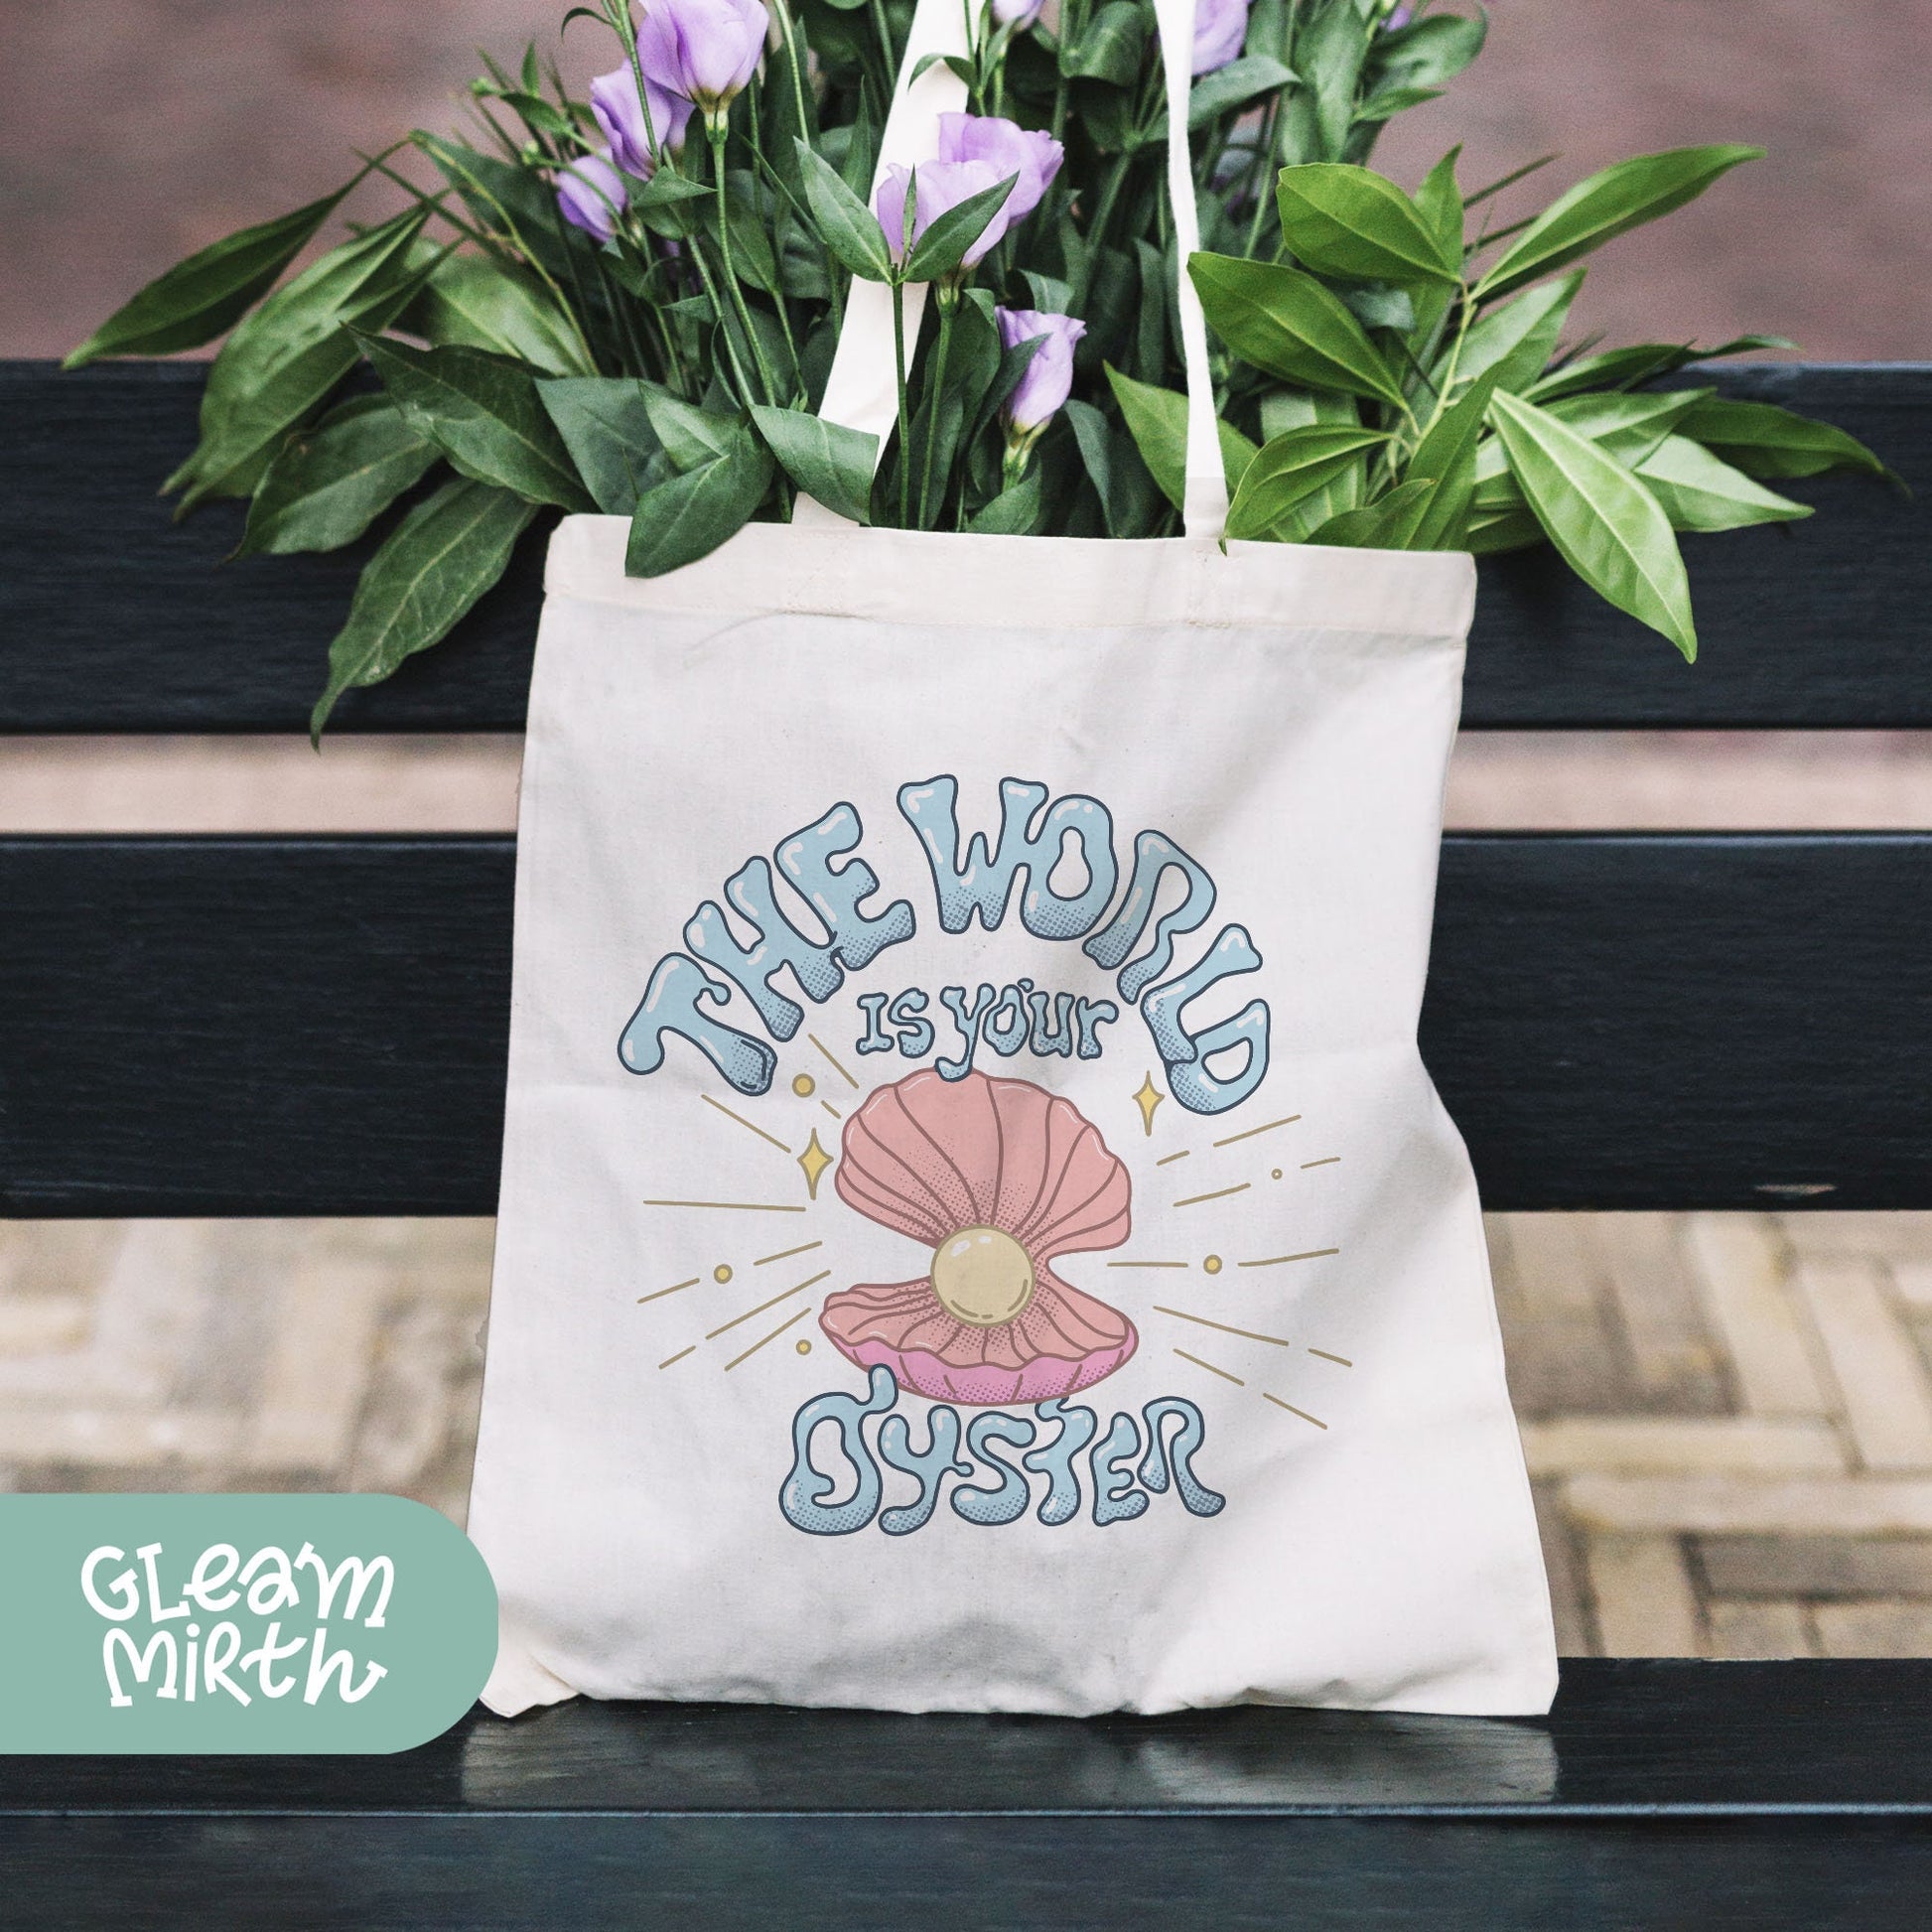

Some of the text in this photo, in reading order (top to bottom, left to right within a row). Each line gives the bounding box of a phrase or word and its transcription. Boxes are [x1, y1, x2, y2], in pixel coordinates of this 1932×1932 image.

[618, 774, 1271, 1115] THE WORLD
[778, 1363, 1227, 1536] OYSTER
